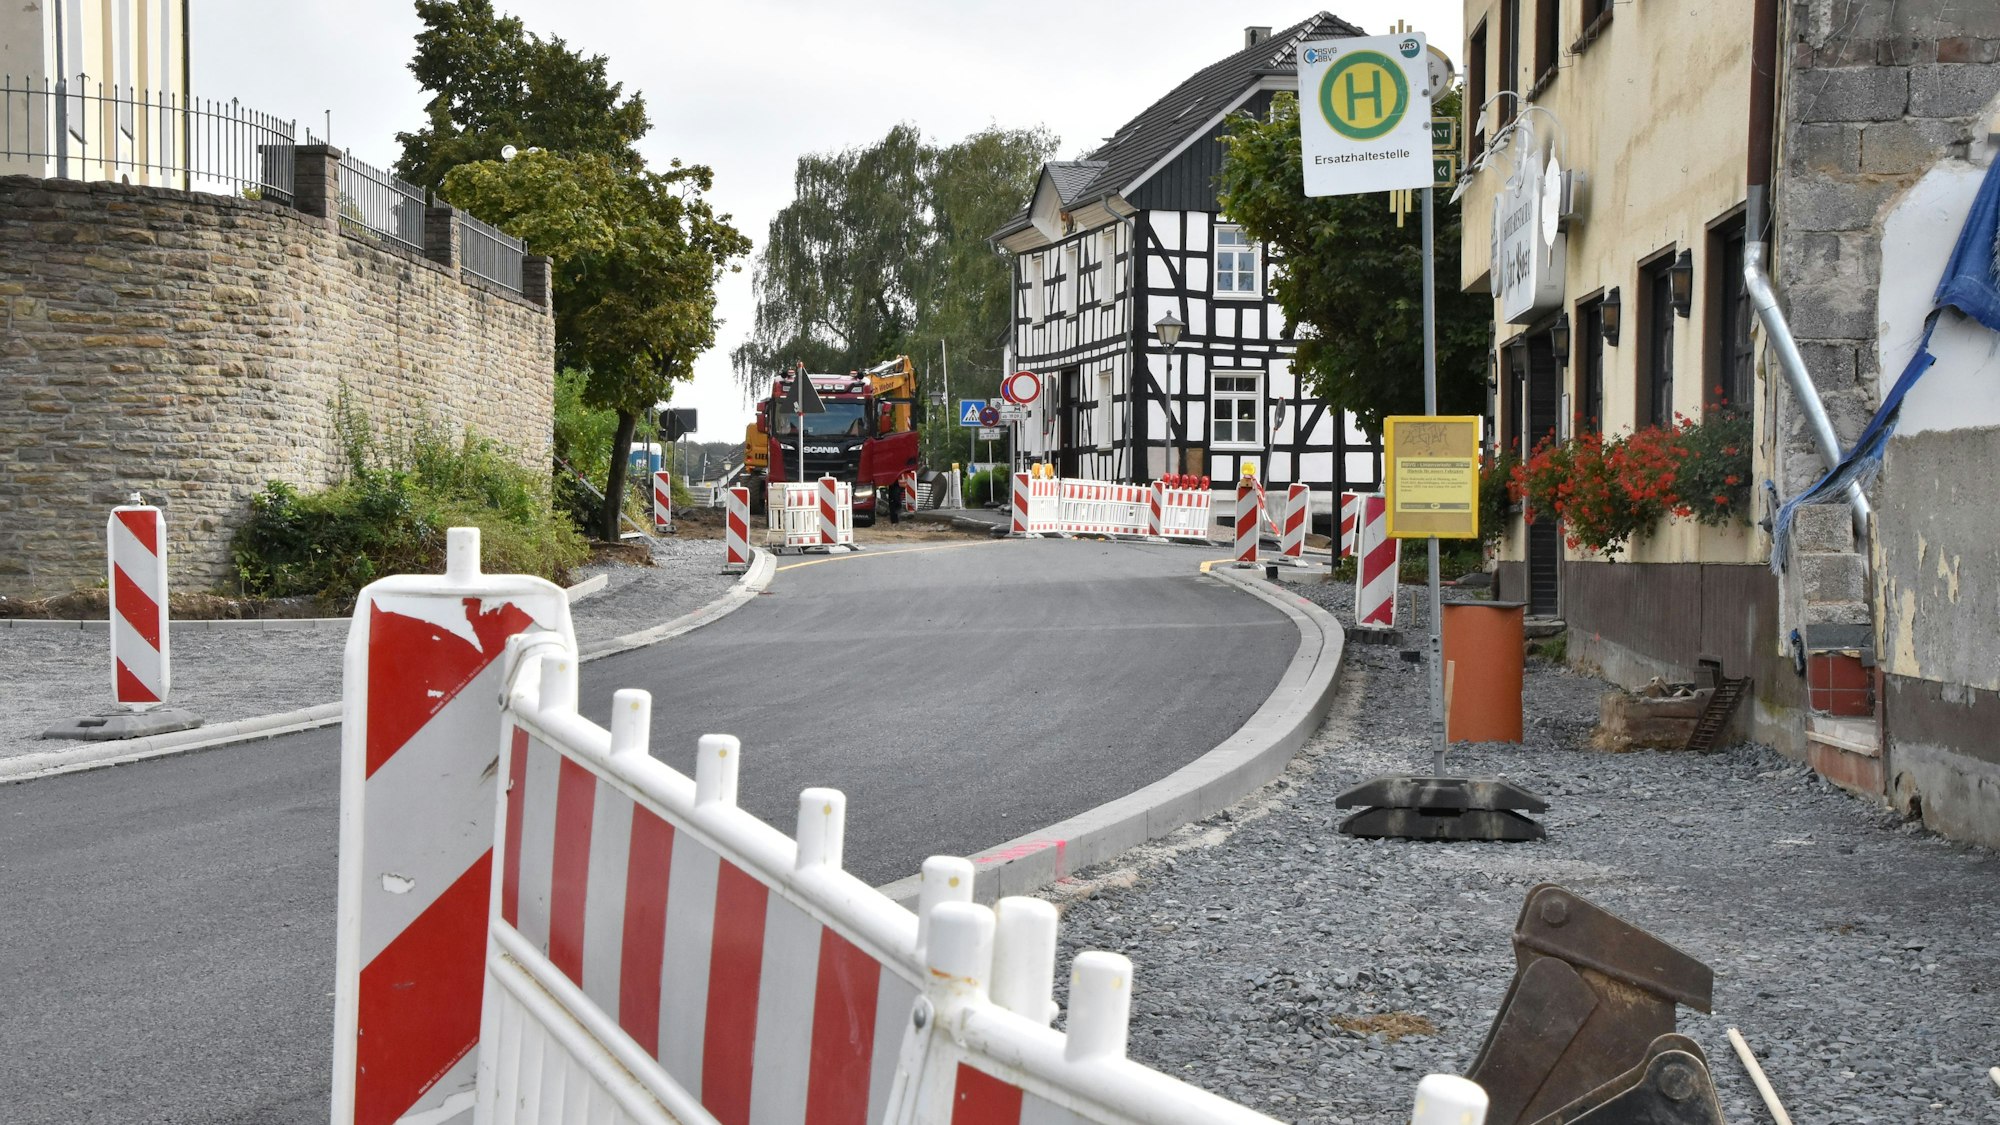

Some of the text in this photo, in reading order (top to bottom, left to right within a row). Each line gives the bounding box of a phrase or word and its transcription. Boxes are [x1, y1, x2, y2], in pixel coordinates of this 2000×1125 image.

[1399, 42, 1415, 51] VRS
[1345, 70, 1383, 121] H
[1315, 149, 1410, 165] Ersatzhaltestelle
[803, 446, 840, 454] SCANIA
